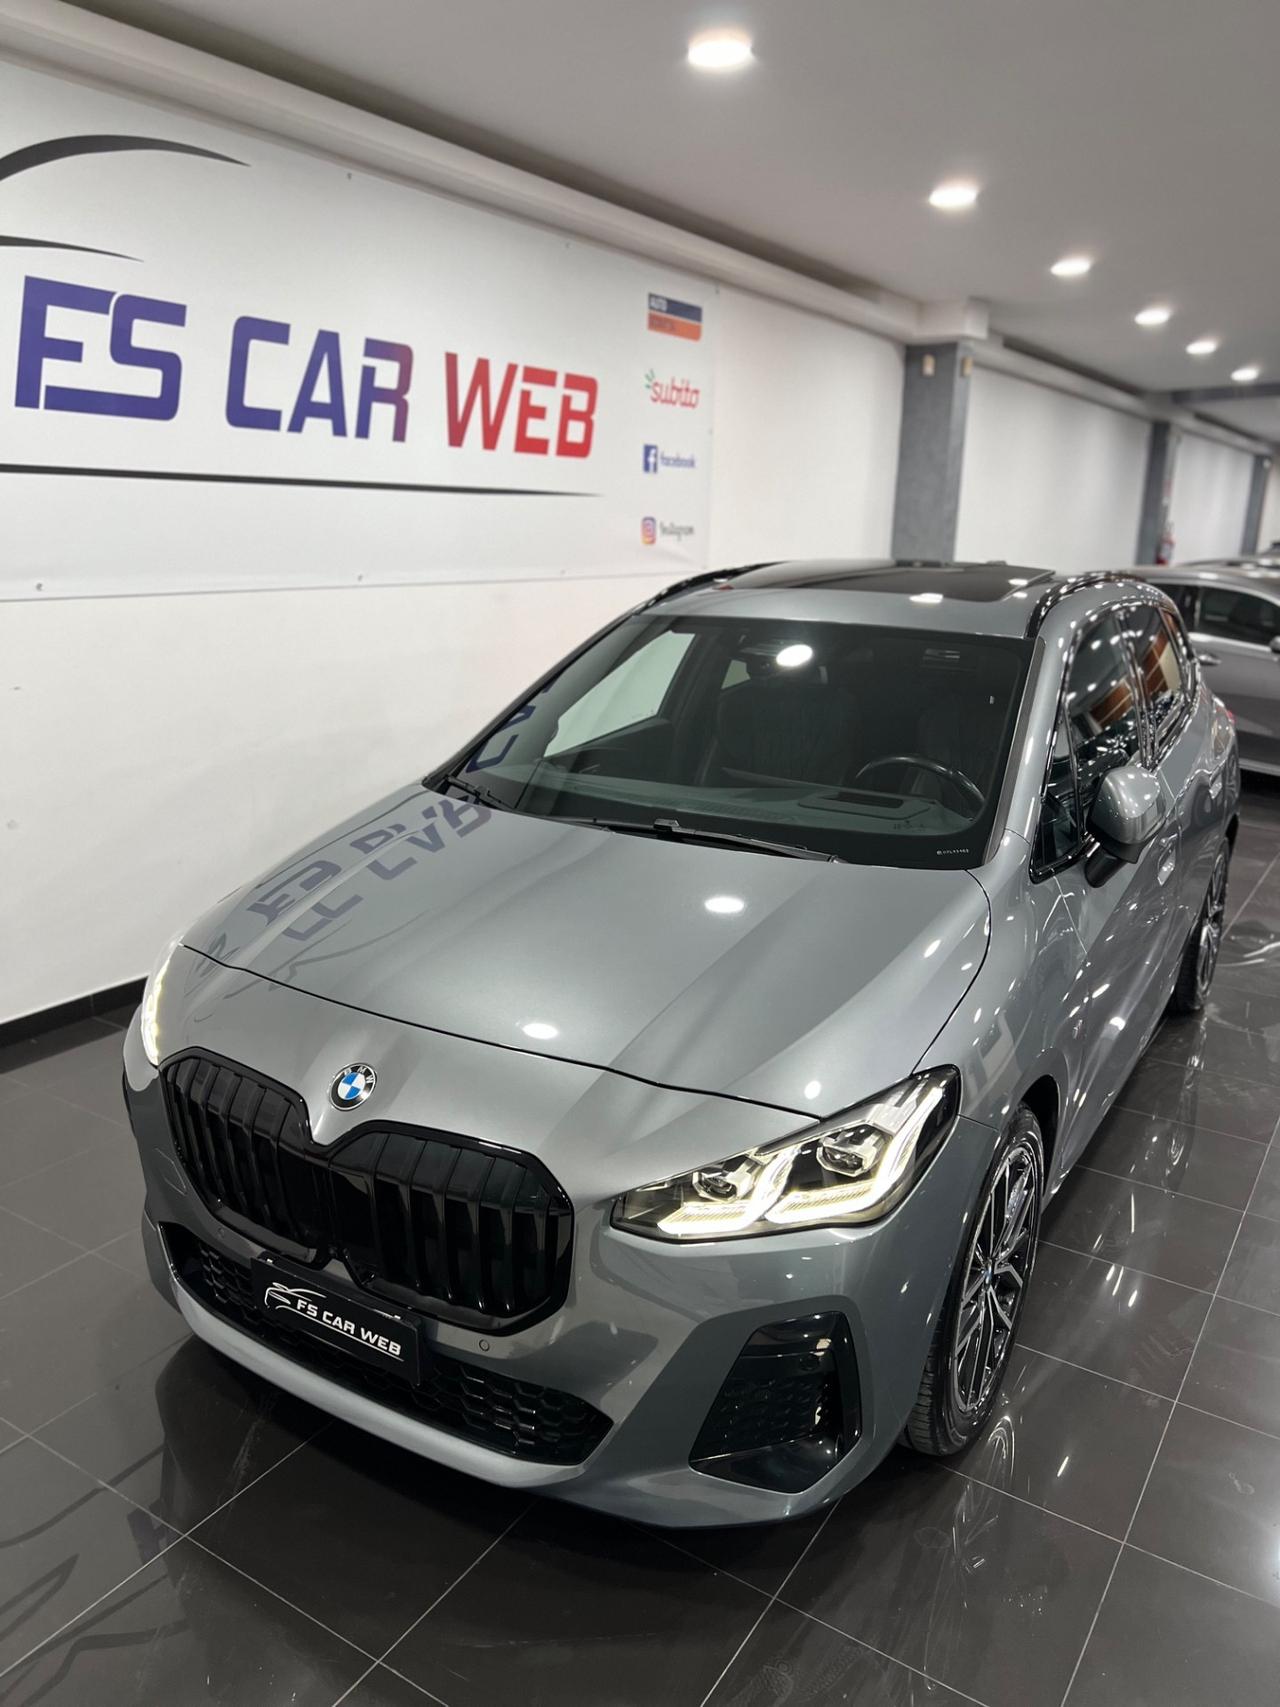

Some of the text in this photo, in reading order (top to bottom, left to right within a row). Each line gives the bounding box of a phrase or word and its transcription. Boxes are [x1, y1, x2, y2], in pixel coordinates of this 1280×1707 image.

[225, 315, 414, 443] CAR
[444, 351, 599, 459] WEB
[651, 376, 700, 409] subito
[296, 1299, 402, 1356] FS CAR WEB
